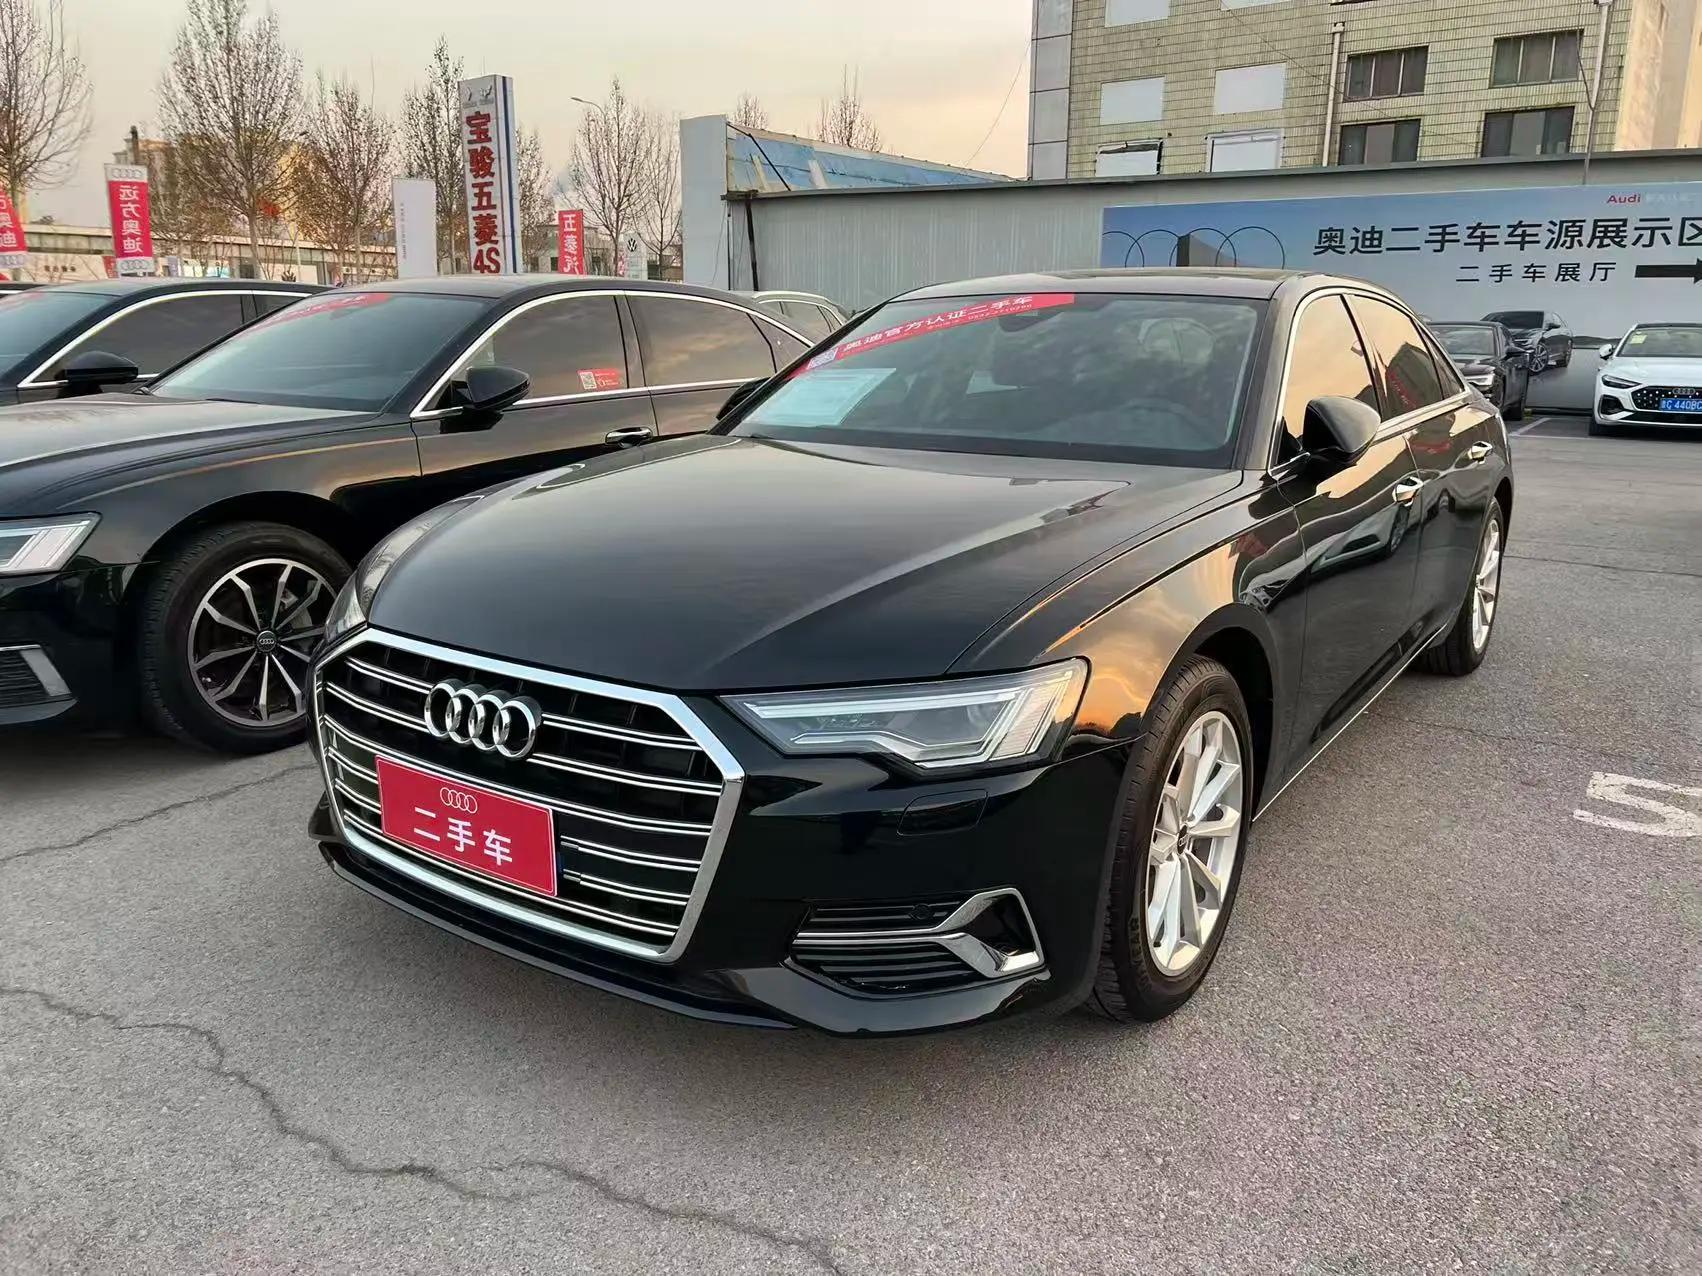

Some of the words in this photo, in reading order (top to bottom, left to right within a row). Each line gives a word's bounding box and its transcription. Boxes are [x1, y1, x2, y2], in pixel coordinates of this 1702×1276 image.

[466, 111, 501, 274] 宝骏五菱4S
[1606, 193, 1641, 204] Audi
[1313, 216, 1702, 256] 奥迪二手车车源展示区
[1455, 261, 1617, 284] 二手车展厅
[414, 806, 513, 866] 二手车
